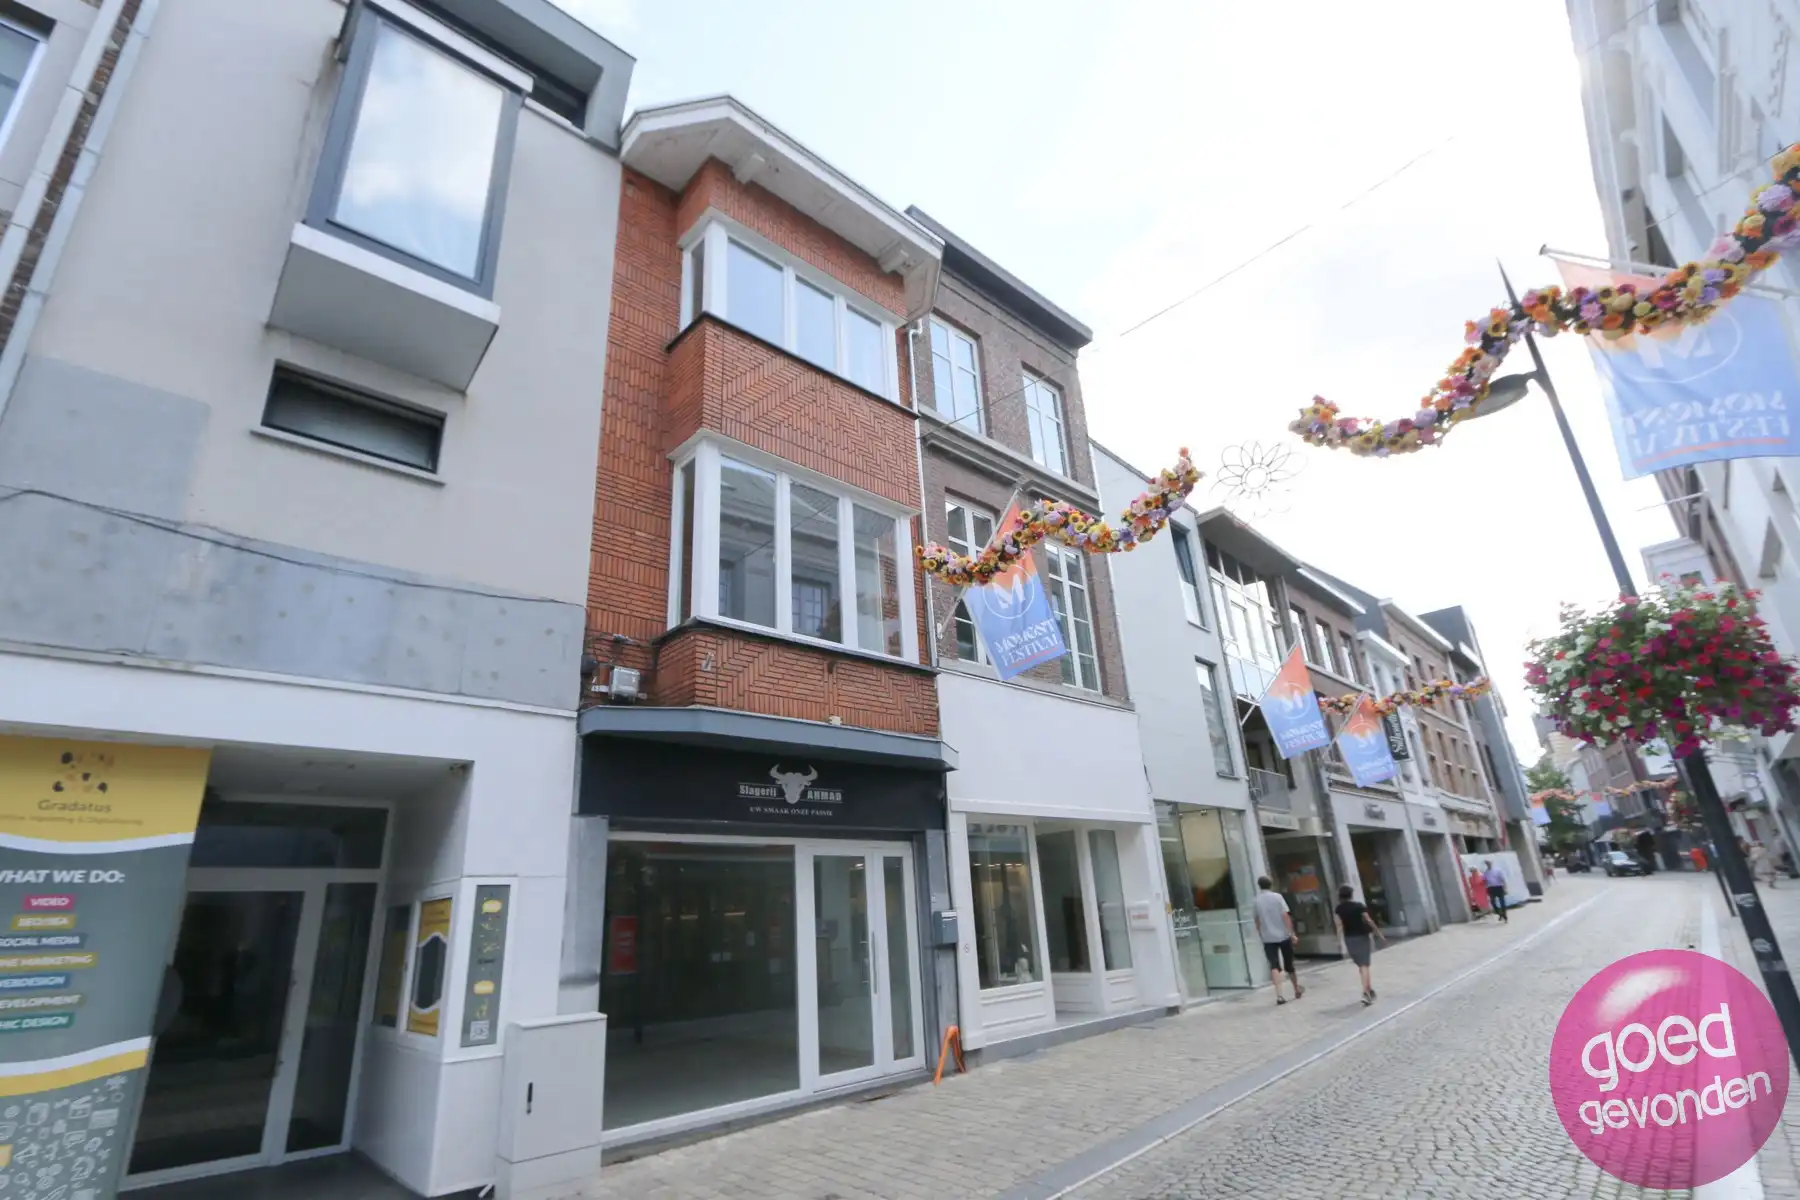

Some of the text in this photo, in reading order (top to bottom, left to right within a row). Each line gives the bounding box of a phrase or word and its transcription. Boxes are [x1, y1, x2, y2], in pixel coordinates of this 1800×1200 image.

[739, 784, 842, 802] Slagerij AHMAD
[37, 798, 113, 813] Gradatus
[52, 869, 88, 884] WE
[88, 869, 126, 884] DO:
[30, 897, 71, 907] VIDEO
[40, 935, 80, 946] MEDIA
[21, 1015, 70, 1028] DESIGN
